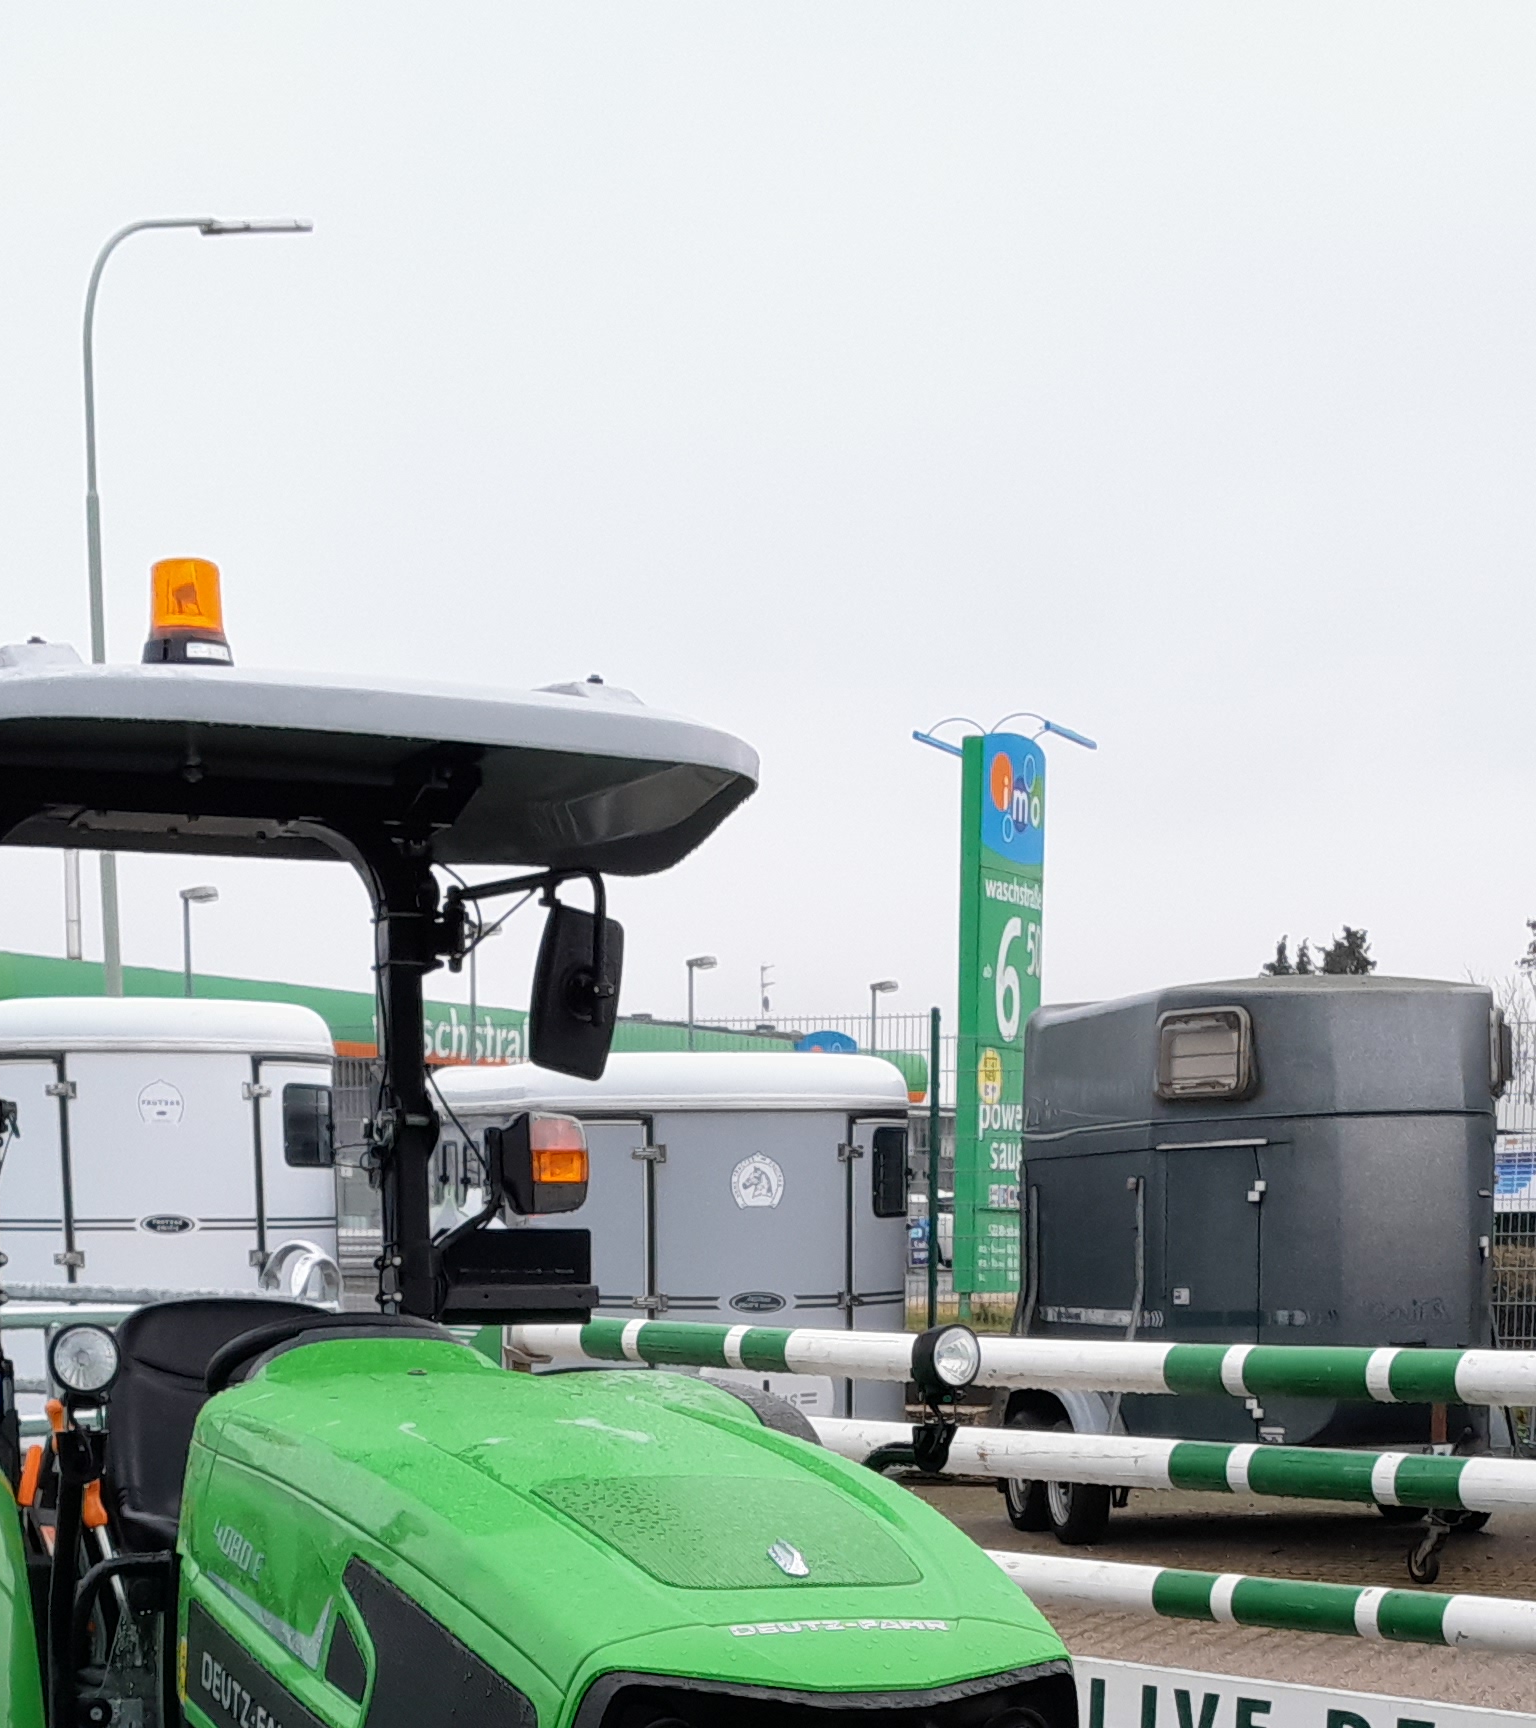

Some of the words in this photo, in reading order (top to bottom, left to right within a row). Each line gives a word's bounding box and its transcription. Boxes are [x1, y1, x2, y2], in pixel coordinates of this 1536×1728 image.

[995, 915, 1022, 1043] 6
[978, 1103, 1022, 1141] powe
[727, 1618, 950, 1637] DEUTZ-FAHR
